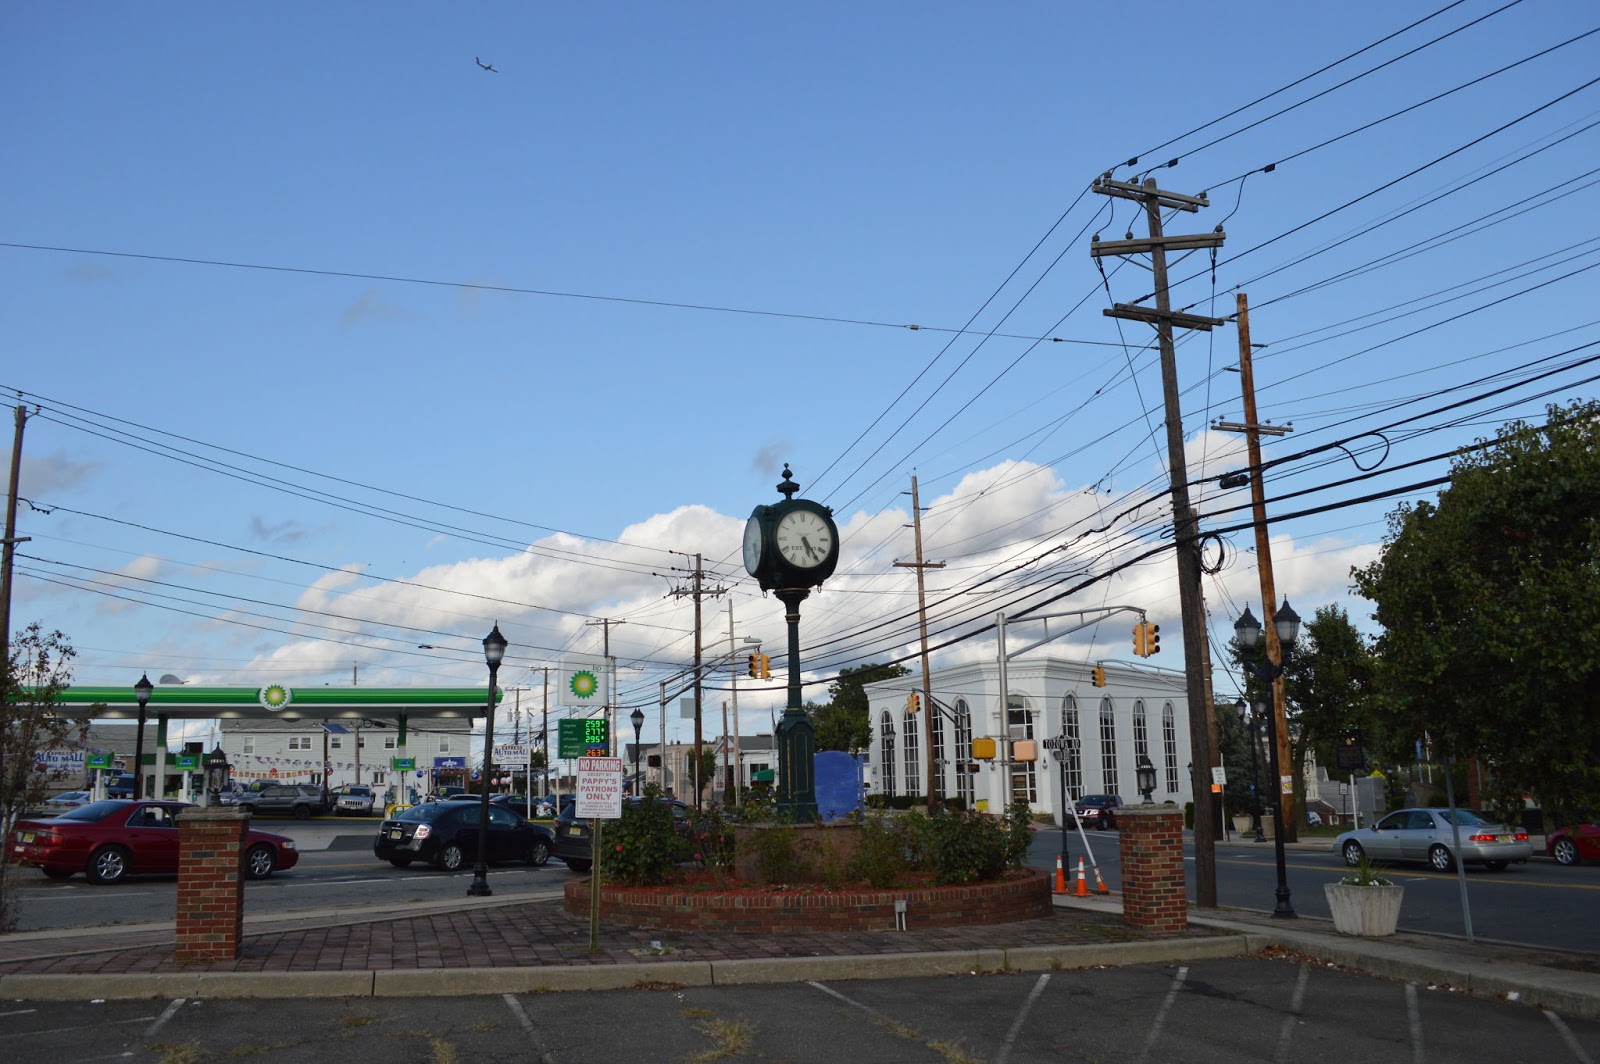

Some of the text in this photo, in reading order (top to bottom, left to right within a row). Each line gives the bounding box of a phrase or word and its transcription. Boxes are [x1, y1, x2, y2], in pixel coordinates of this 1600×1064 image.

[592, 664, 602, 672] bp
[62, 752, 84, 762] MALL
[580, 760, 620, 771] NO PARKING
